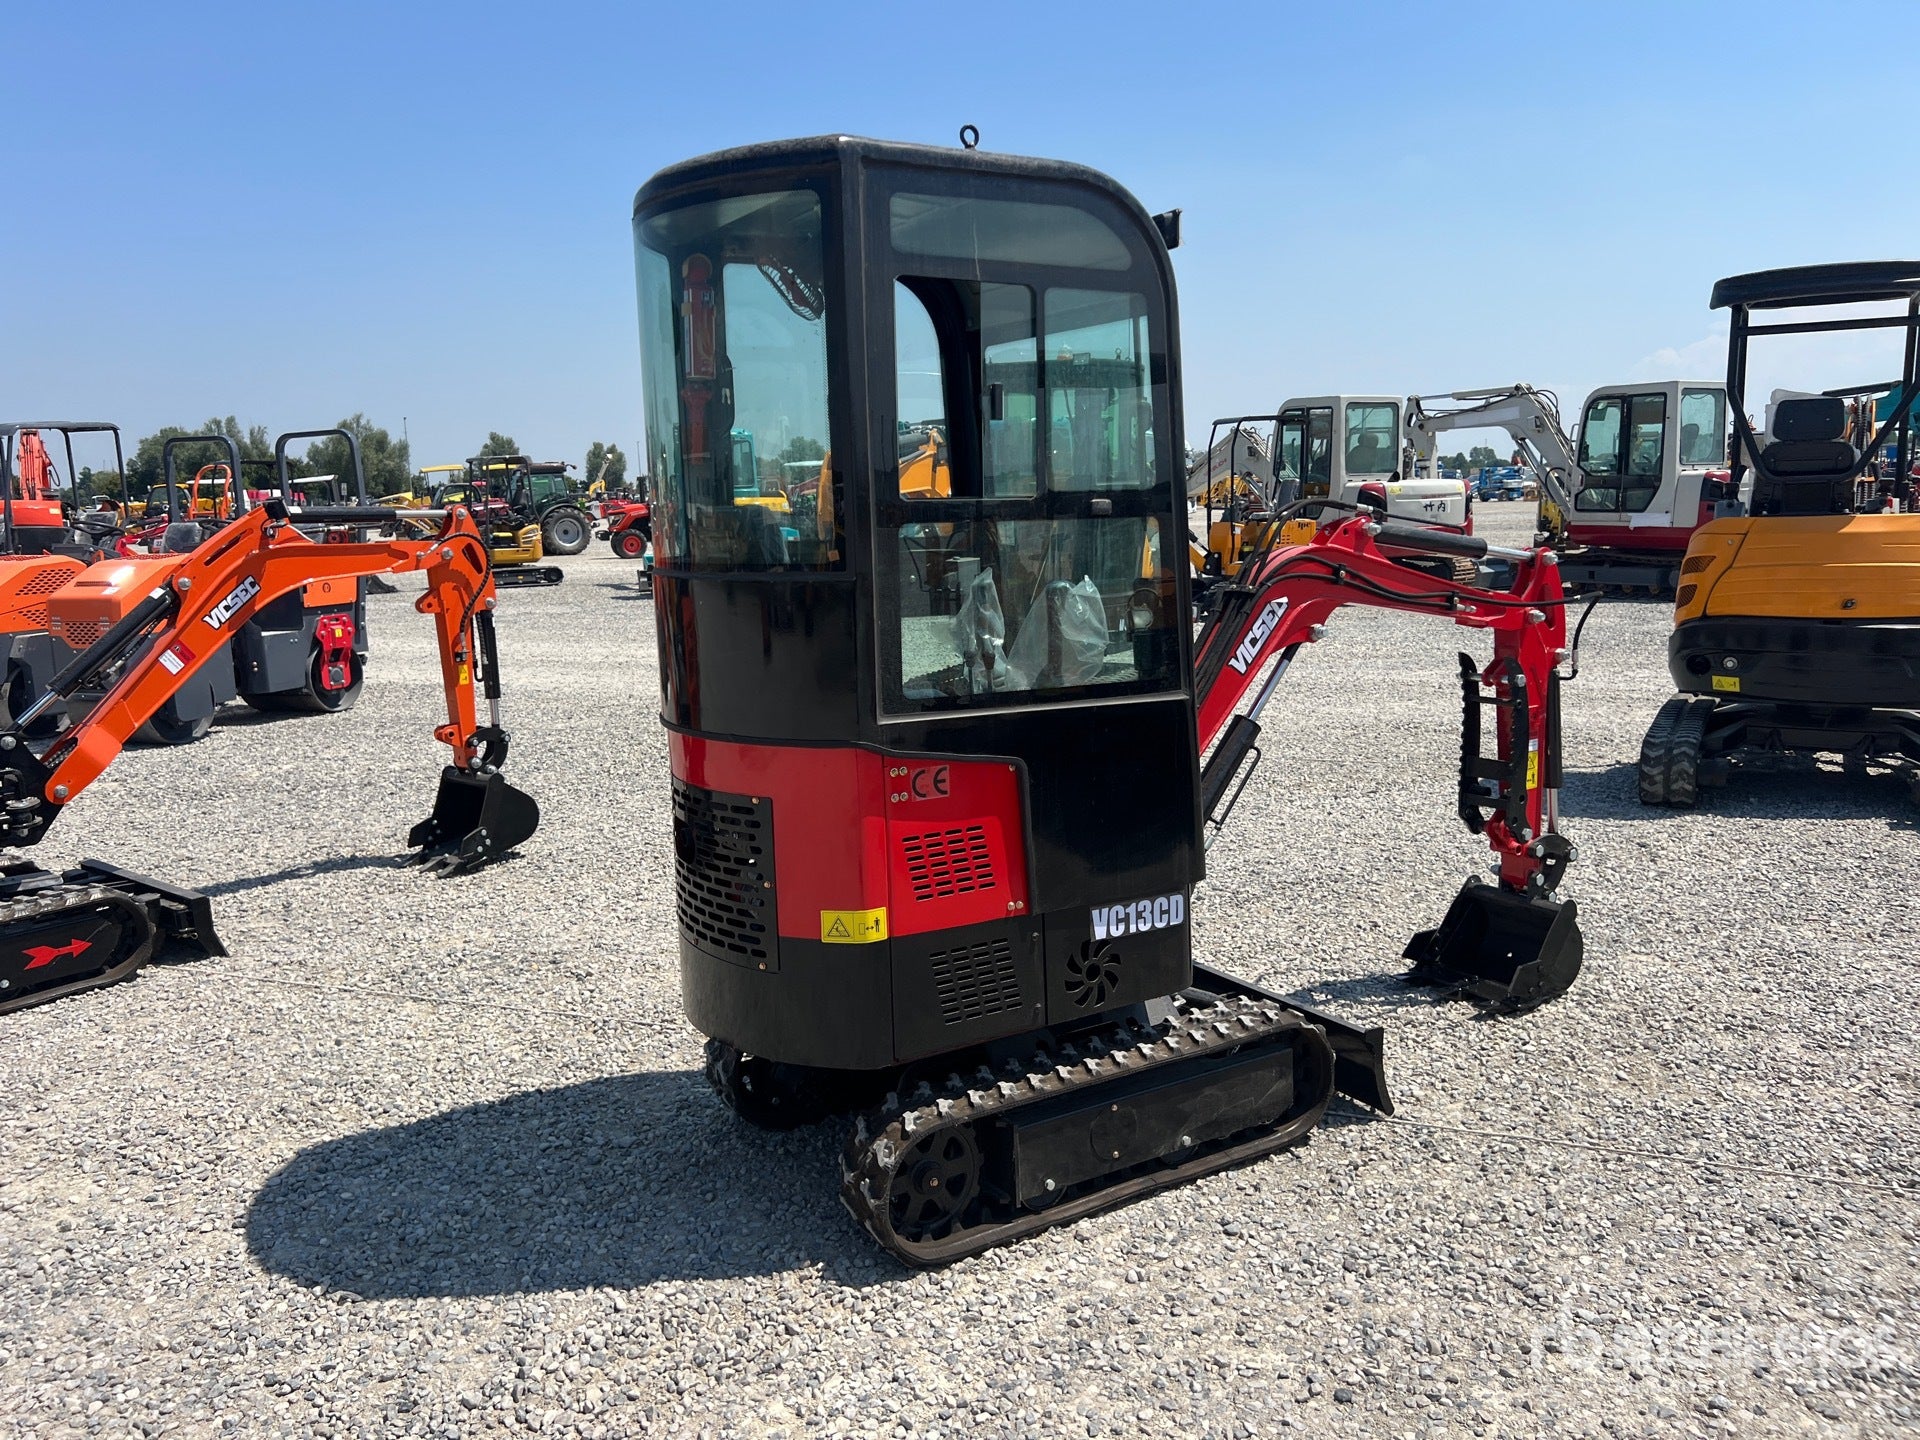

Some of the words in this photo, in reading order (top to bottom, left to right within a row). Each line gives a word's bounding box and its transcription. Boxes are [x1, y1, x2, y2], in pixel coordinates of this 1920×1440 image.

[202, 575, 261, 630] VICSEC
[911, 766, 948, 798] CE
[1091, 894, 1184, 940] VC13CD
